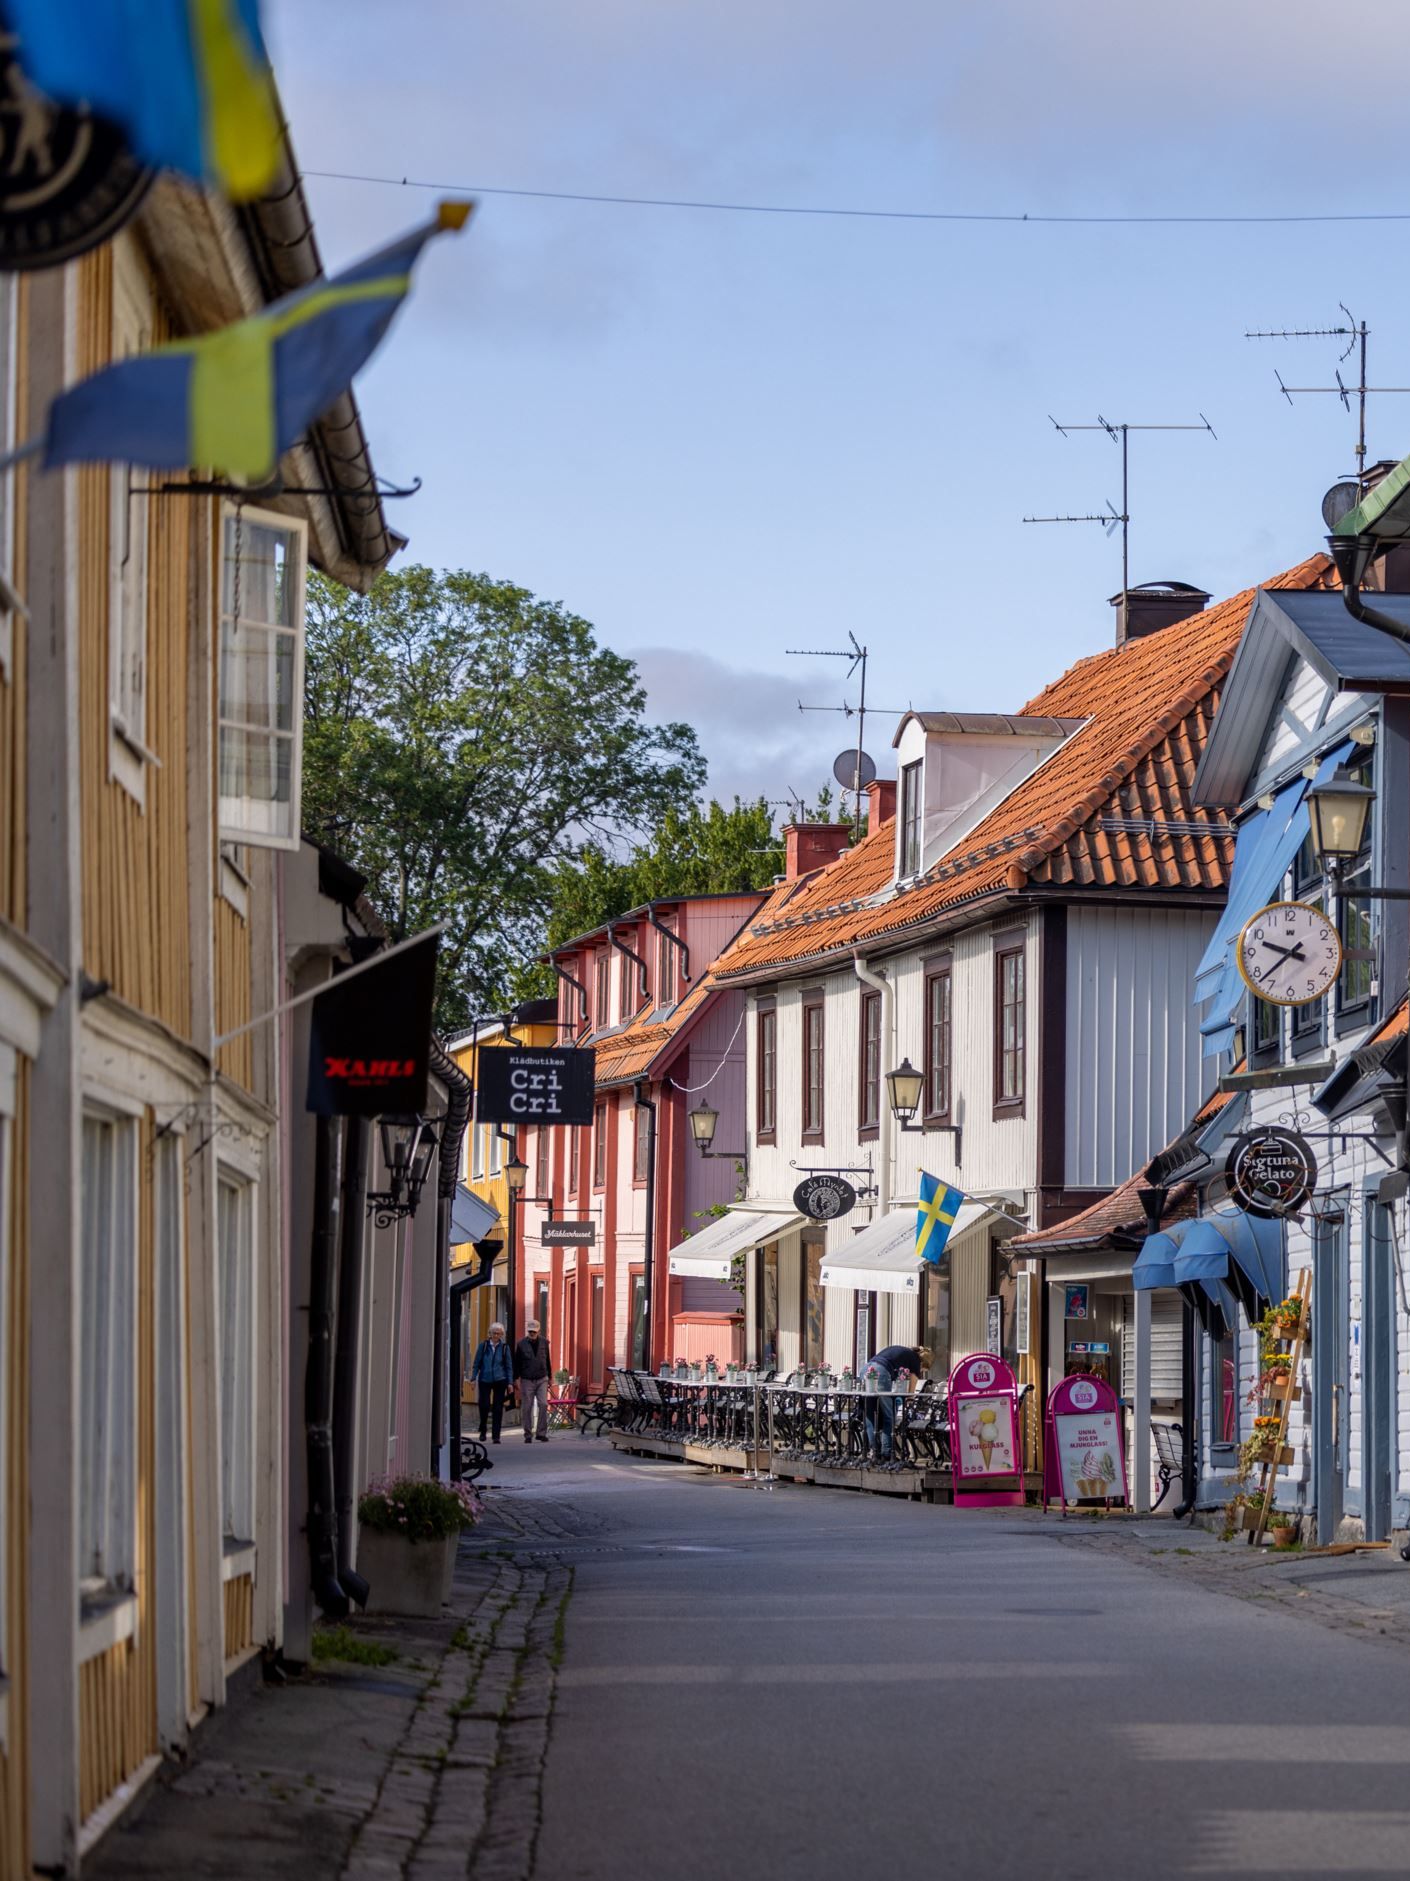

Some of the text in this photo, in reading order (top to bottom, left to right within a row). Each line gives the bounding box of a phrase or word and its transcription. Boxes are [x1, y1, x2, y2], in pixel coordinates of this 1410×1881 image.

[1268, 916, 1277, 927] 11
[1284, 910, 1296, 922] 12
[1254, 928, 1265, 940] 10
[1319, 929, 1329, 941] 2
[1247, 947, 1256, 959] 9
[1325, 947, 1334, 959] 3
[1252, 966, 1262, 978] 8
[1318, 966, 1328, 977] 4
[1267, 979, 1276, 991] 7
[1286, 985, 1295, 997] 6
[1306, 979, 1315, 991] 5
[509, 1056, 566, 1066] Klädbutiken
[510, 1069, 563, 1090] Cri
[509, 1092, 562, 1113] Cri
[1243, 1154, 1299, 1171] Sigtuna
[1248, 1167, 1295, 1180] Gelato
[969, 1441, 1004, 1450] KULGLASS
